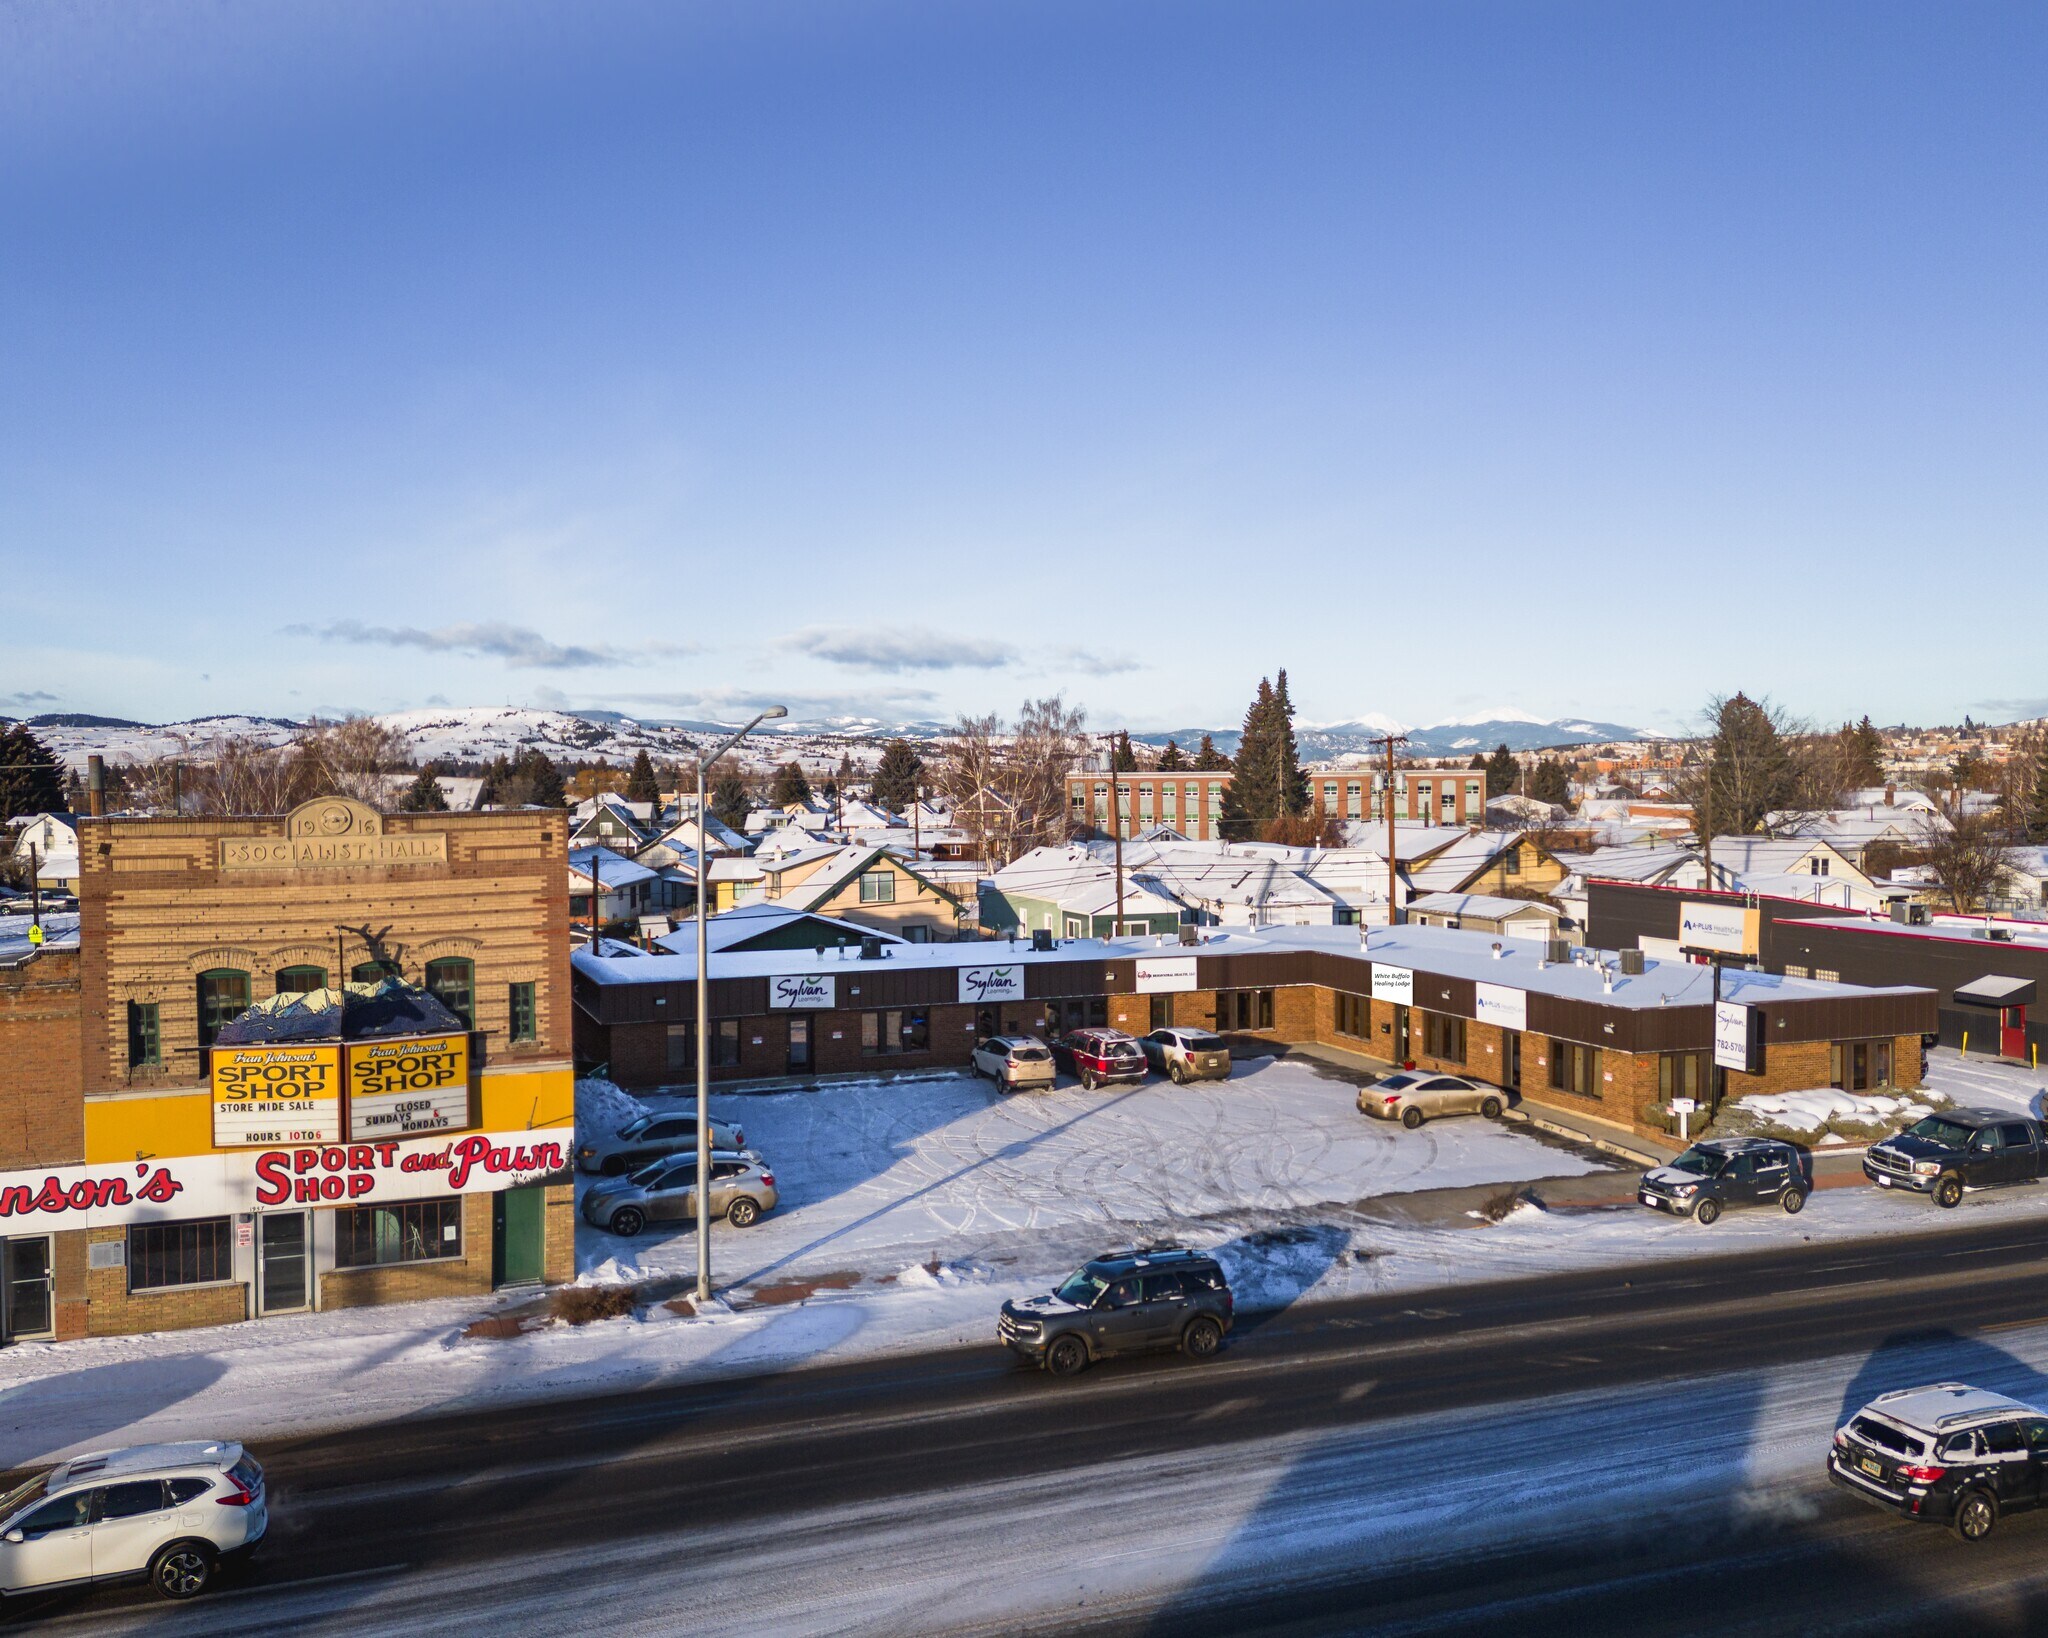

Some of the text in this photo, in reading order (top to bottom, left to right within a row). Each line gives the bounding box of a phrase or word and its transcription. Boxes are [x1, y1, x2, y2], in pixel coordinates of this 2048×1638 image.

[298, 819, 375, 835] 19 16
[236, 841, 432, 862] SOCIALIST HALL
[777, 979, 828, 1008] Sylvan
[966, 971, 1017, 1001] Sylvan
[368, 1040, 447, 1058] Fran Johnson's
[1717, 1039, 1746, 1054] 782-5700
[232, 1050, 317, 1065] Fran Johnson's
[354, 1052, 462, 1077] SPORT
[218, 1064, 333, 1082] SPORT
[361, 1070, 455, 1093] SHOP
[226, 1082, 325, 1099] SHOP
[220, 1101, 314, 1112] STORE WIDE SALE
[395, 1100, 431, 1112] CLOSED
[366, 1112, 411, 1126] SUNDAYS
[402, 1118, 448, 1131] MONDAYS
[246, 1132, 281, 1141] HOURS
[400, 1142, 454, 1172] and
[448, 1136, 565, 1190] Pawn
